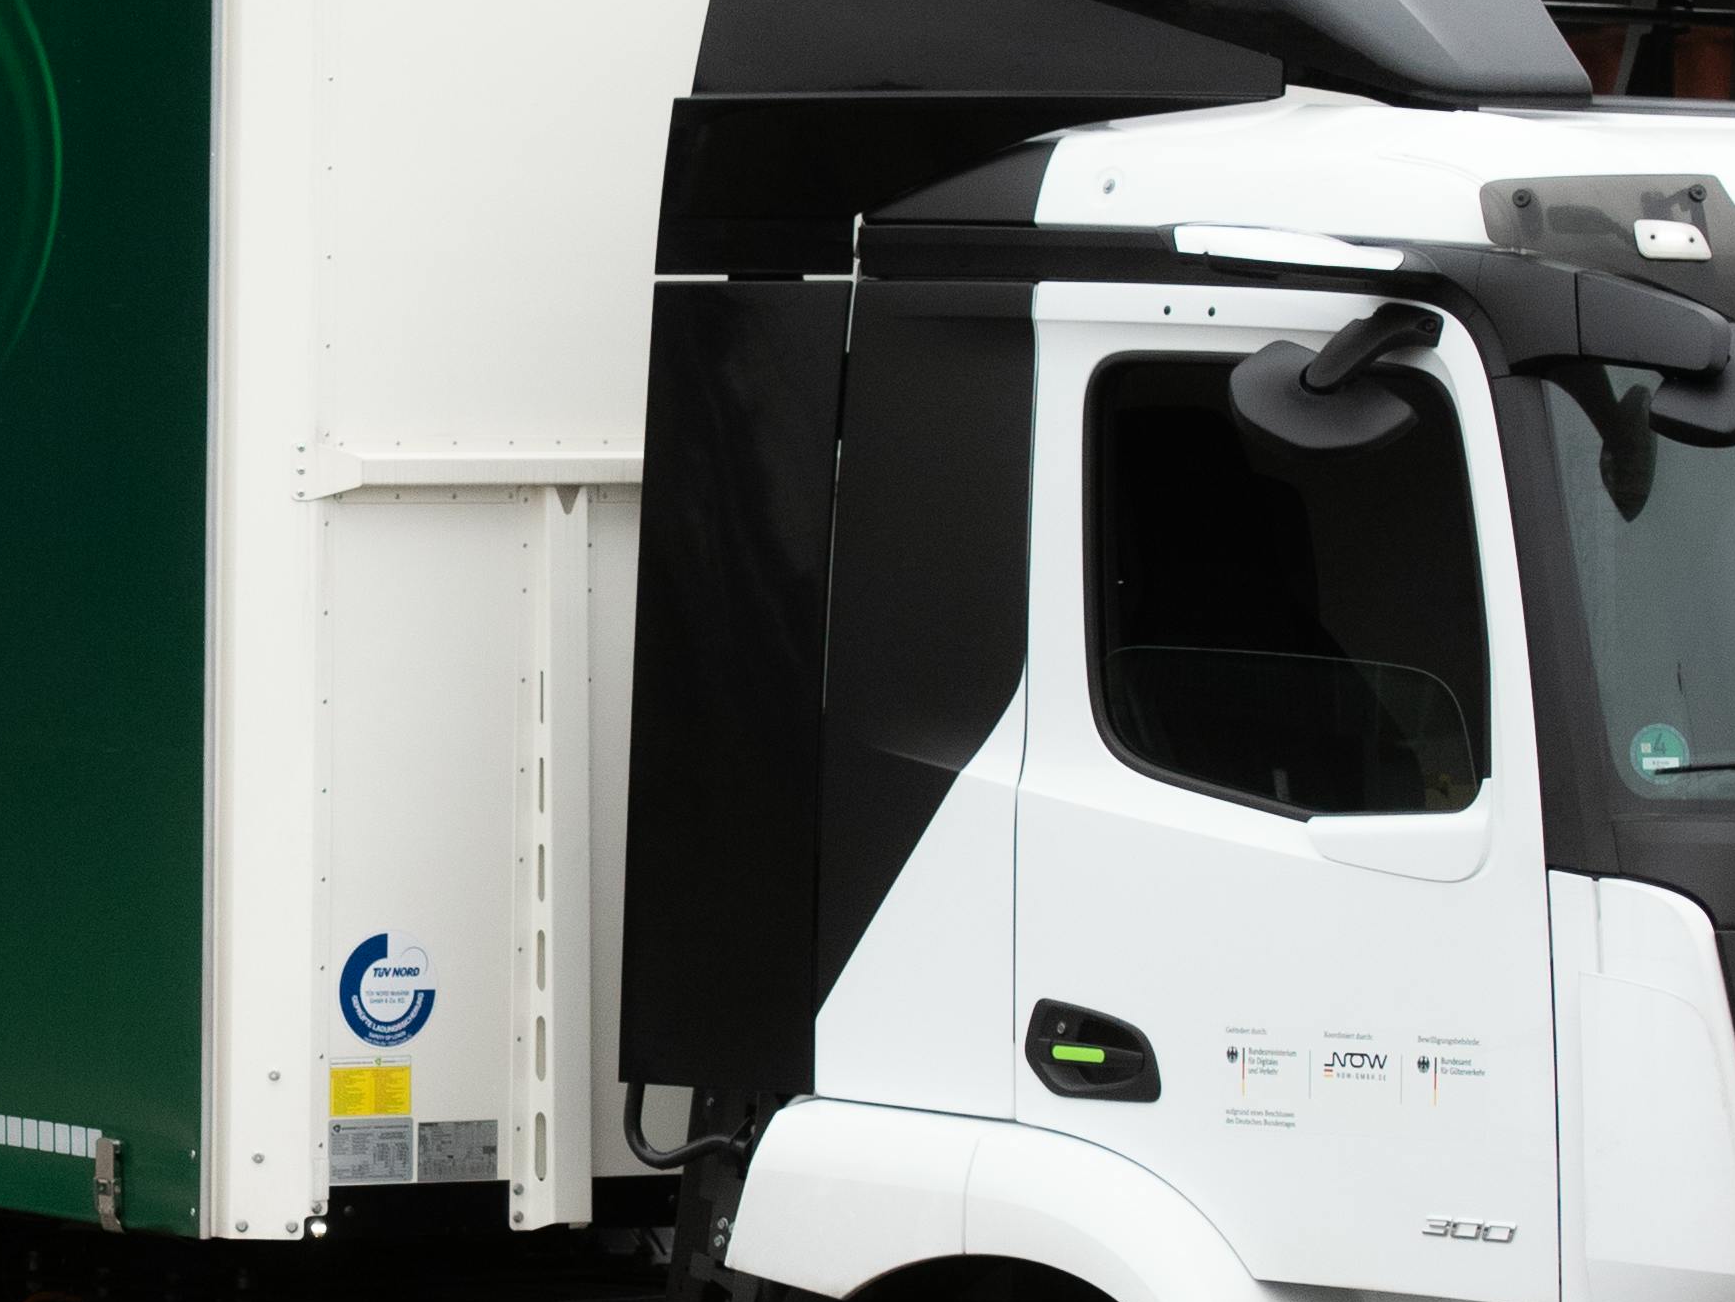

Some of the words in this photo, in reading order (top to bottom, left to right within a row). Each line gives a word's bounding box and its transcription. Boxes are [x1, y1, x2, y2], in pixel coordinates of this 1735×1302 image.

[1654, 733, 1666, 754] 4
[373, 967, 391, 978] TÜV
[391, 967, 420, 977] NORD
[1325, 1052, 1388, 1069] NOW
[1421, 1214, 1517, 1244] 300
